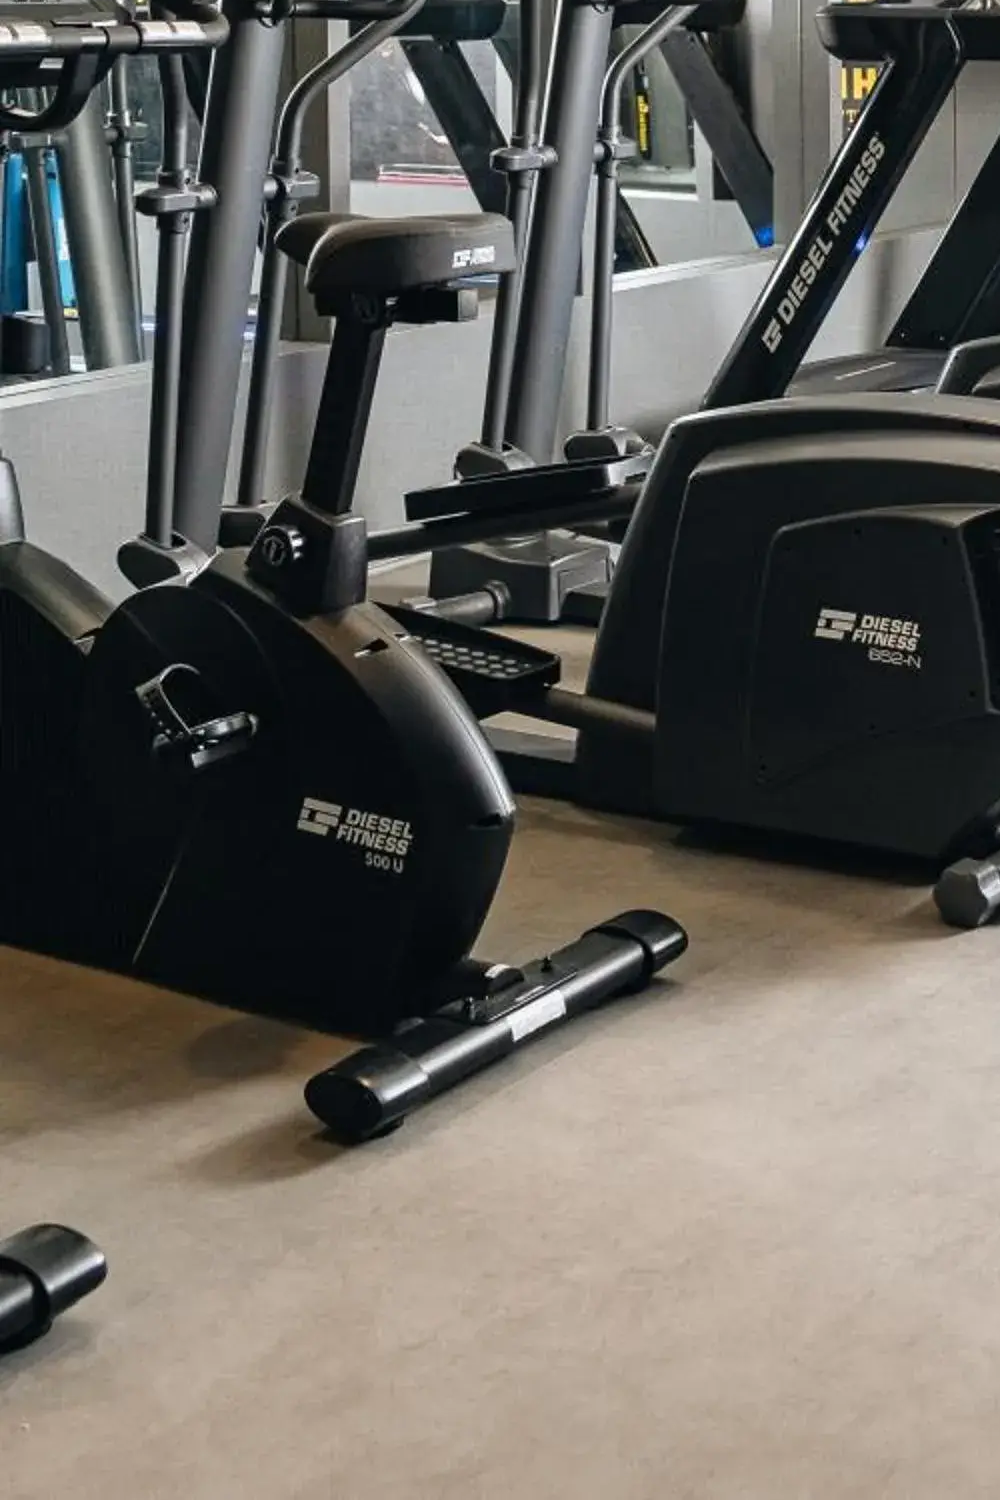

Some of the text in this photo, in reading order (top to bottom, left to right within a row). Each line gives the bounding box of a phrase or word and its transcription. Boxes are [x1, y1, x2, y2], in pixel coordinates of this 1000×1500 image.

[778, 237, 834, 325] DIESEL
[827, 136, 886, 236] FITNESS
[853, 629, 918, 652] FITNESS
[862, 615, 921, 637] DIESEL
[346, 809, 412, 839] DIESEL
[337, 825, 409, 855] FITNESS
